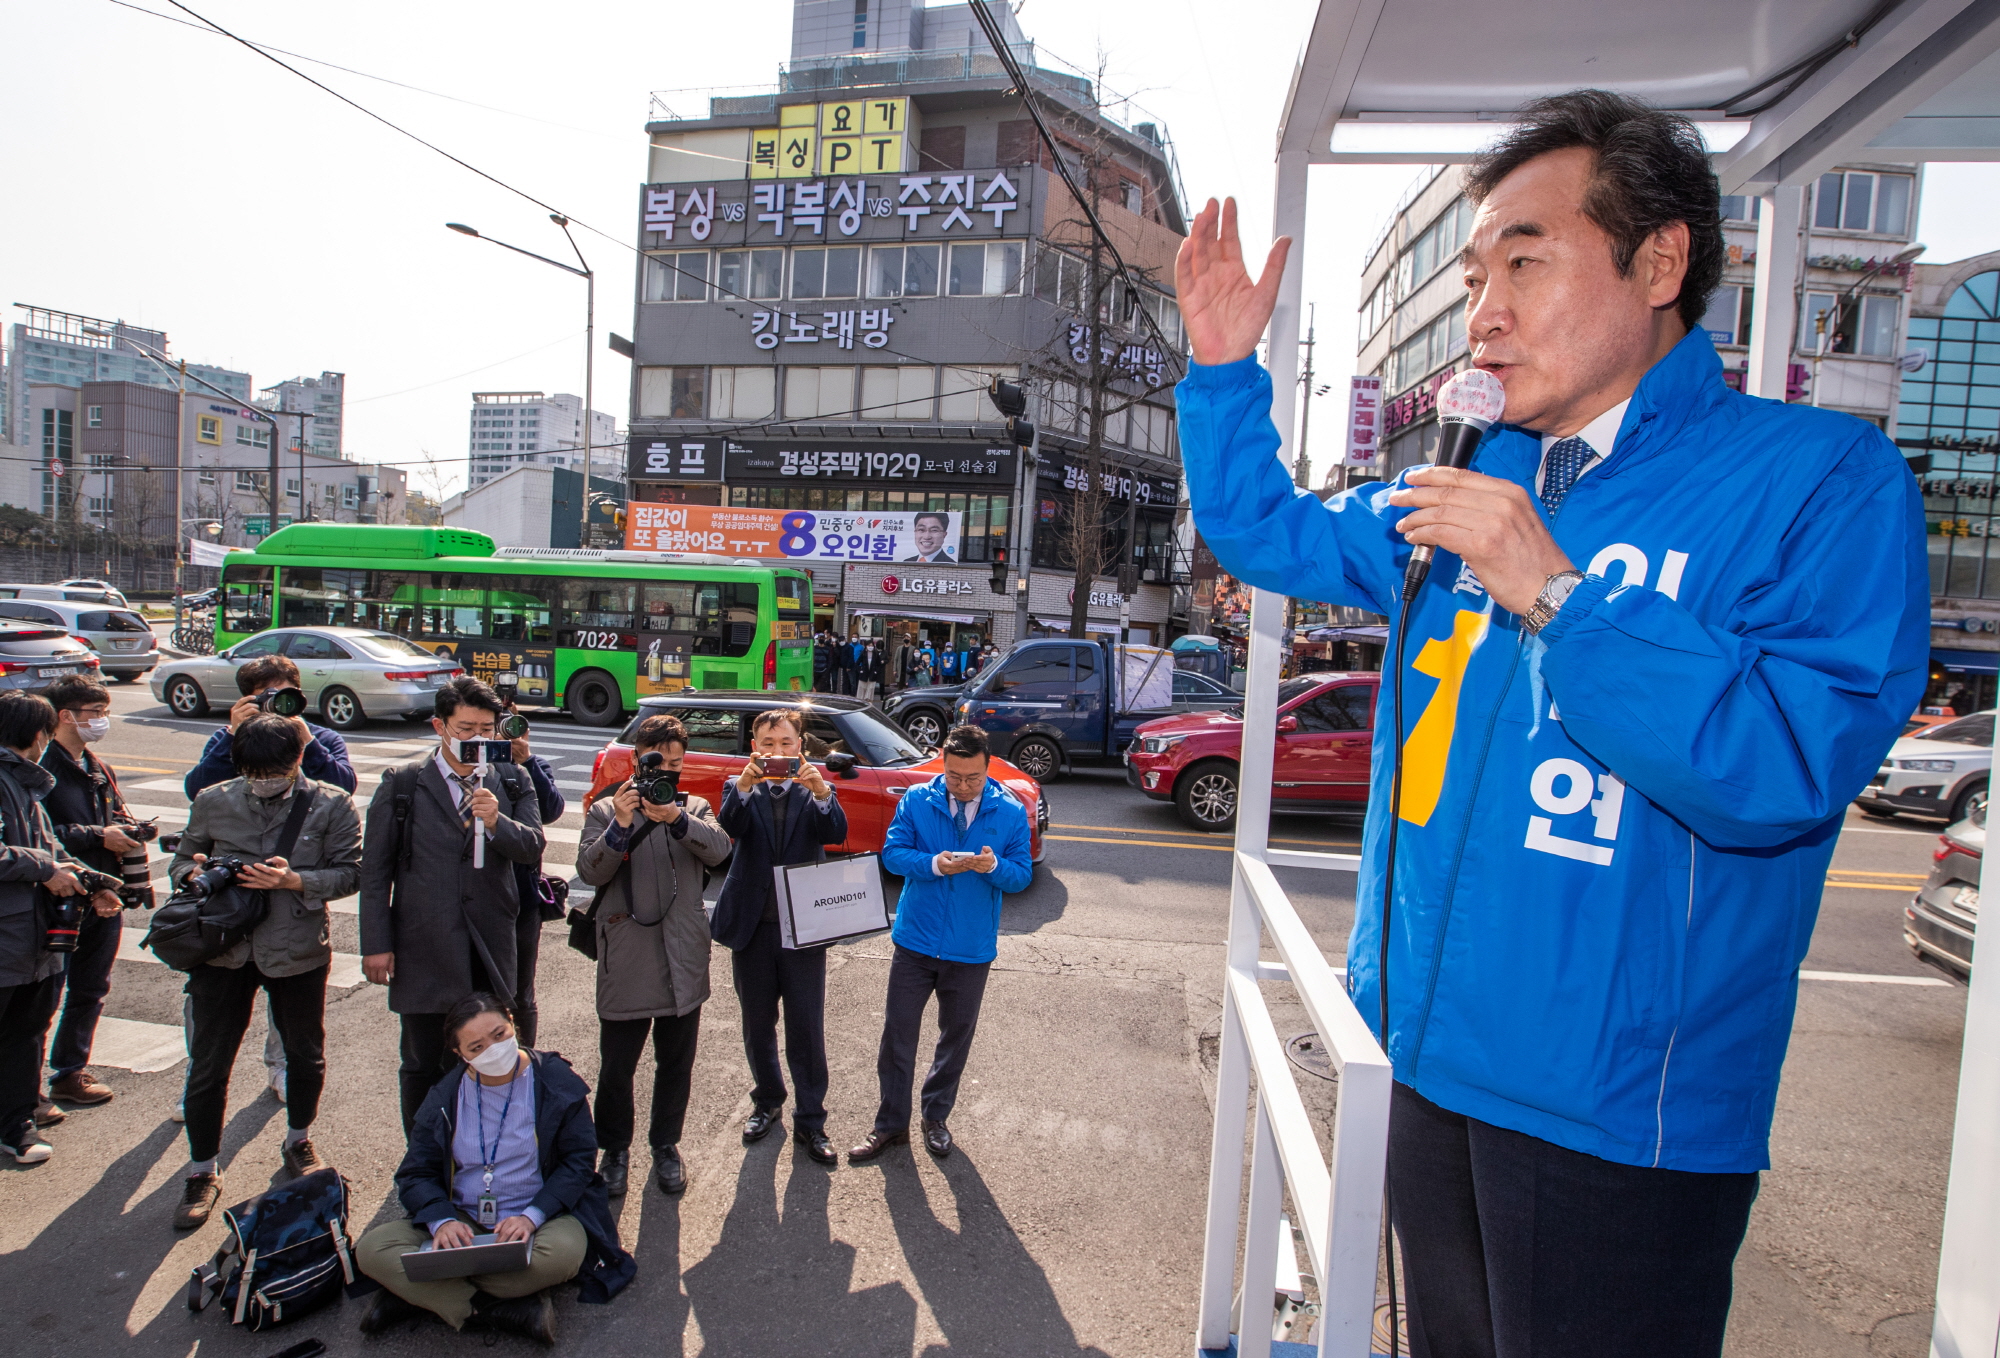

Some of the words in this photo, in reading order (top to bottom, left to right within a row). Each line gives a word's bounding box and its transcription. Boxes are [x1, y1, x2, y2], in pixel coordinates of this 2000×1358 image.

[832, 102, 896, 132] 요가
[754, 138, 808, 169] 복싱
[830, 139, 892, 173] PT
[645, 187, 716, 241] 복싱
[754, 180, 866, 236] 킥복싱
[897, 172, 1018, 232] 주짓수
[751, 307, 894, 349] 킹노래방
[748, 459, 774, 467] izakaya
[779, 451, 921, 478] 경성주막1929
[1351, 448, 1375, 461] 3F
[635, 507, 688, 529] 집값이
[820, 518, 856, 532] 민중당
[632, 530, 651, 547] 또
[655, 530, 726, 552] 올랐어요
[778, 511, 817, 557] 8
[820, 534, 897, 561] 오인환
[902, 578, 973, 595] LG유플러스
[577, 630, 618, 650] 7022
[472, 652, 511, 670] 보습을
[814, 891, 867, 908] AROUND101
